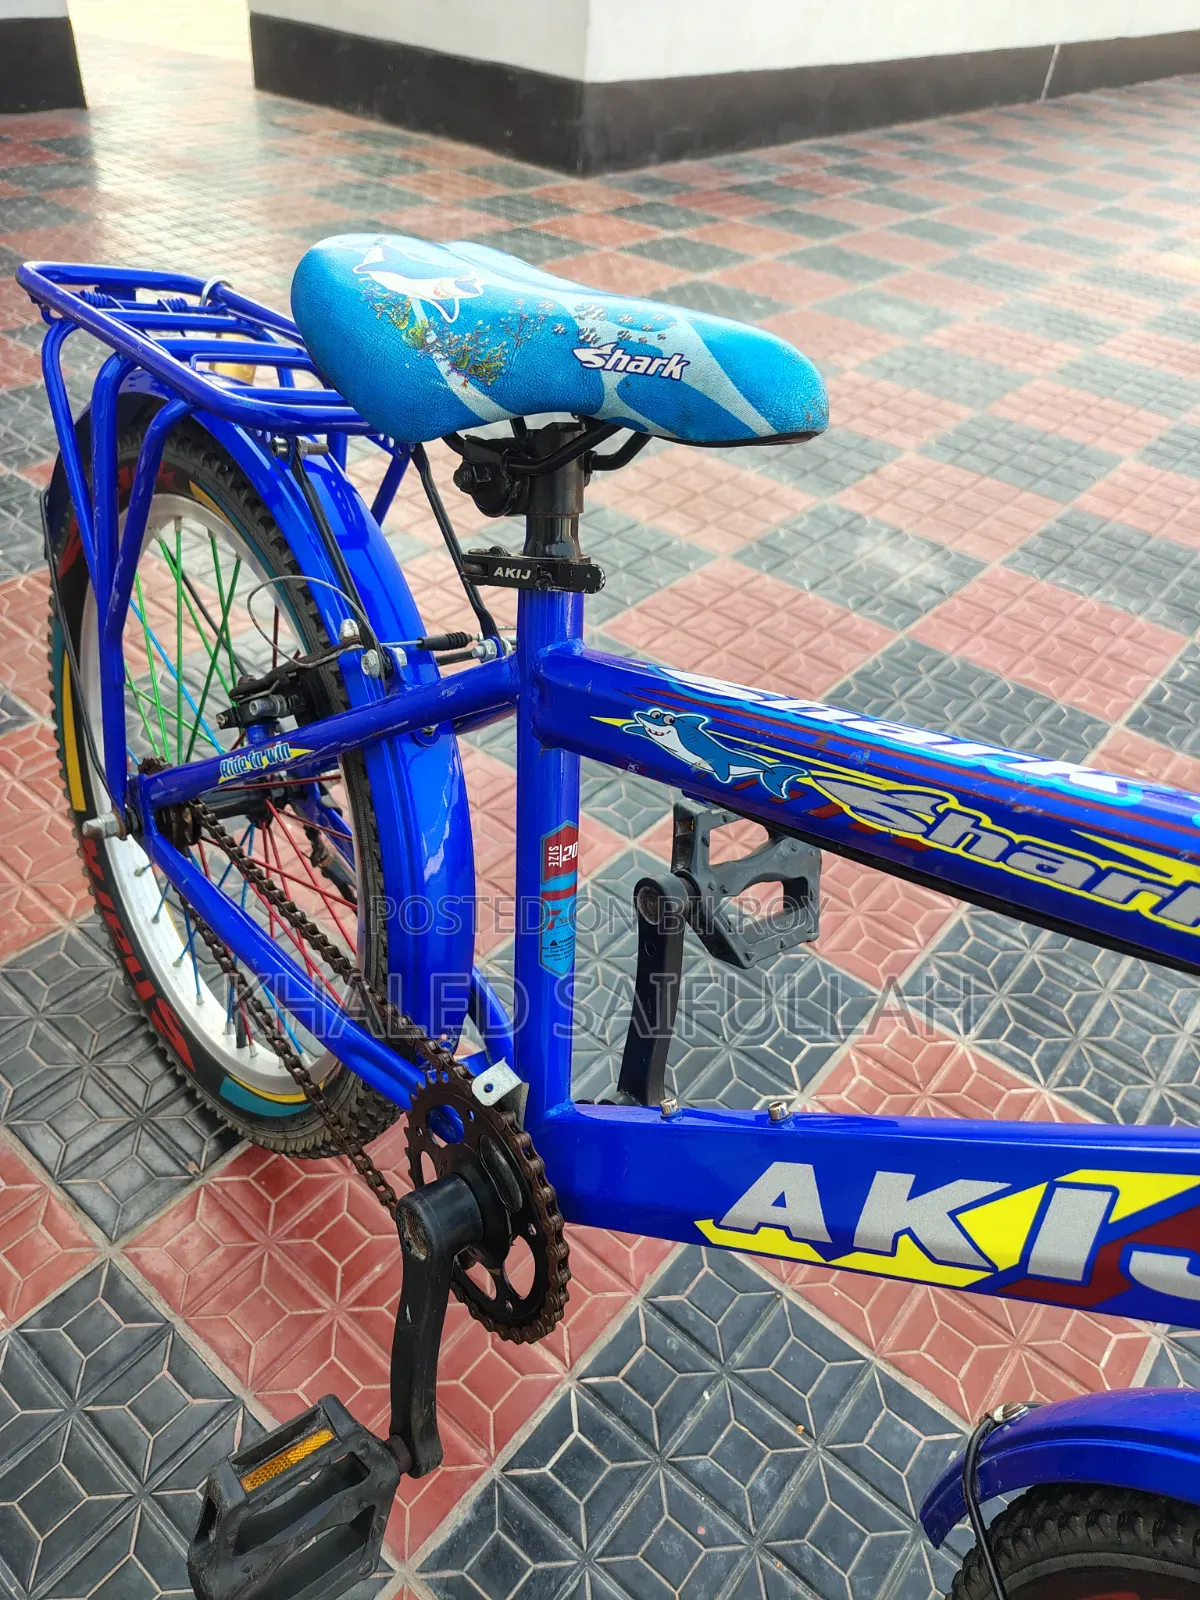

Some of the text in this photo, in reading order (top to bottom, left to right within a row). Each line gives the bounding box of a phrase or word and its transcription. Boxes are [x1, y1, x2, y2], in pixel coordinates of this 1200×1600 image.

[573, 342, 690, 381] Shark
[493, 566, 532, 580] AKIJ
[220, 741, 293, 778] Ride to win
[548, 845, 560, 867] SIZE
